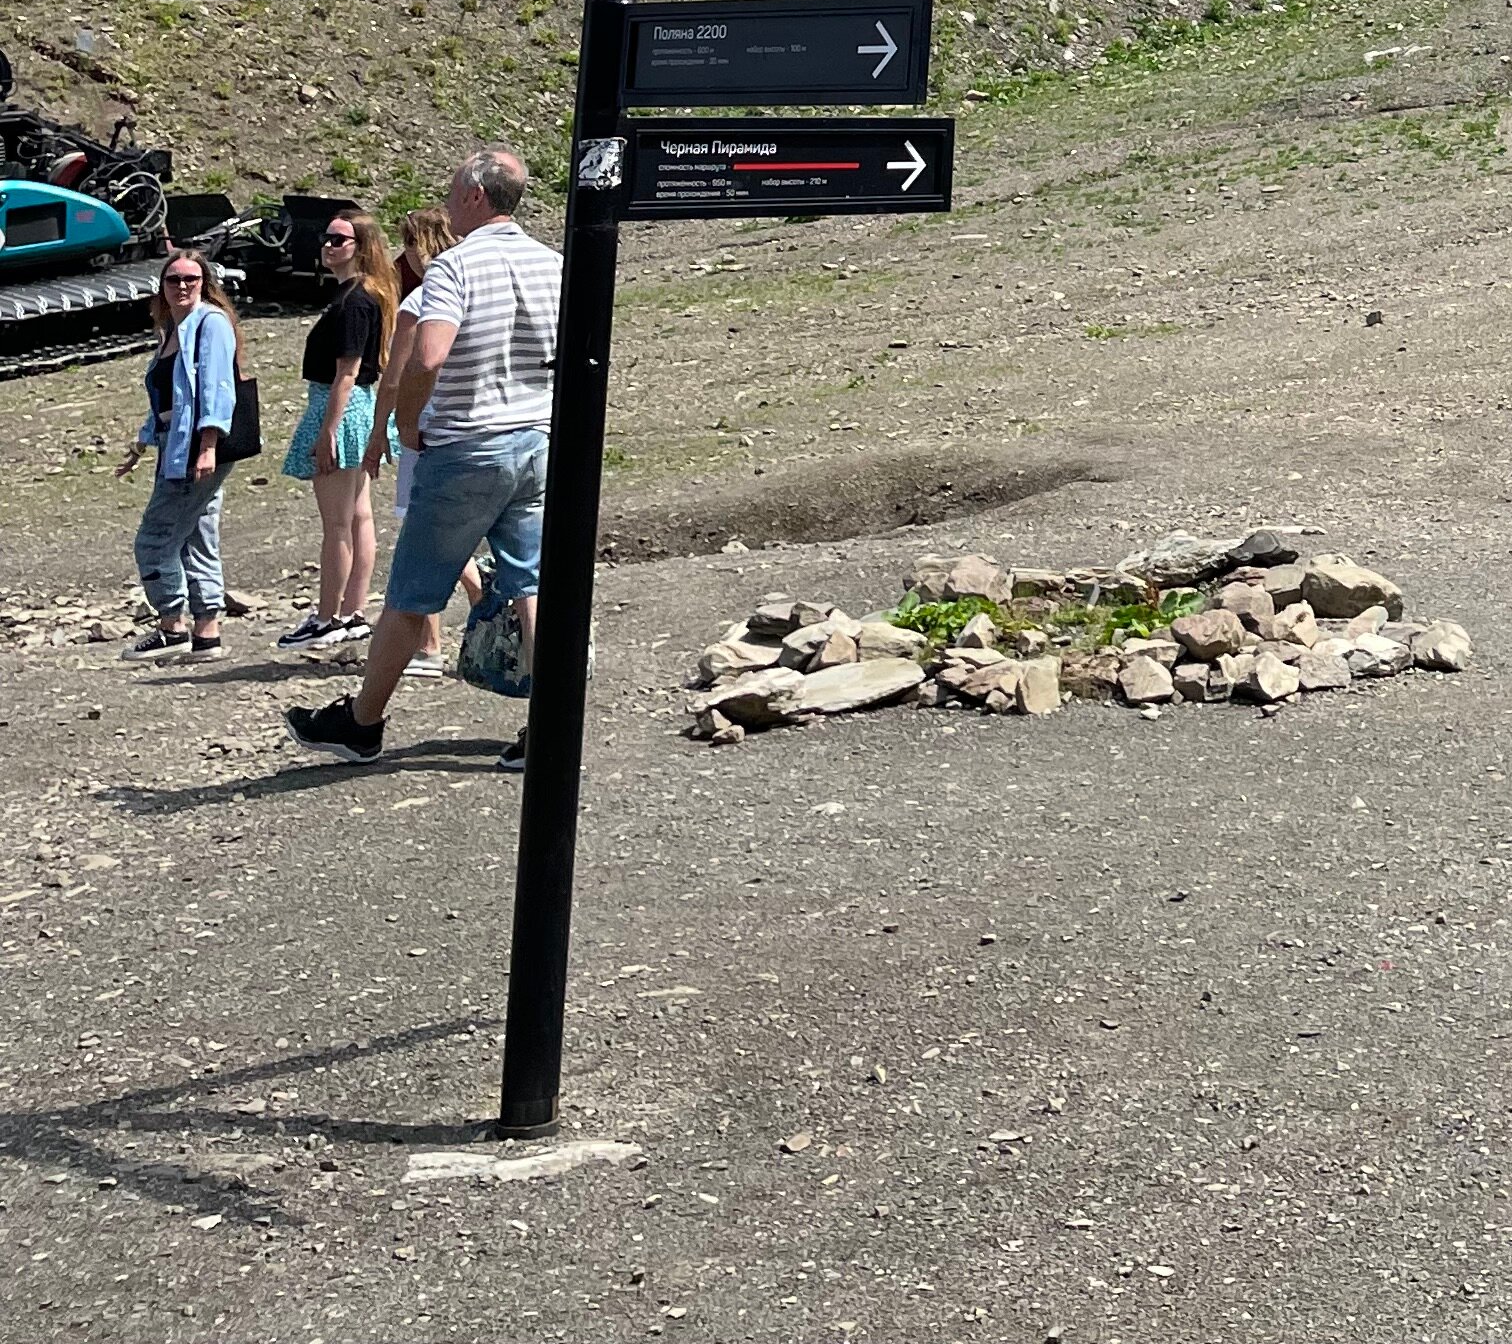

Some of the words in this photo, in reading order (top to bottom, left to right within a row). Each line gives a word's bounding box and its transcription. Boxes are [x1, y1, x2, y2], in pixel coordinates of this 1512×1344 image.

[653, 26, 694, 40] Поляна
[696, 24, 728, 39] 2200
[660, 140, 708, 158] Черная
[711, 140, 777, 158] Пирамида
